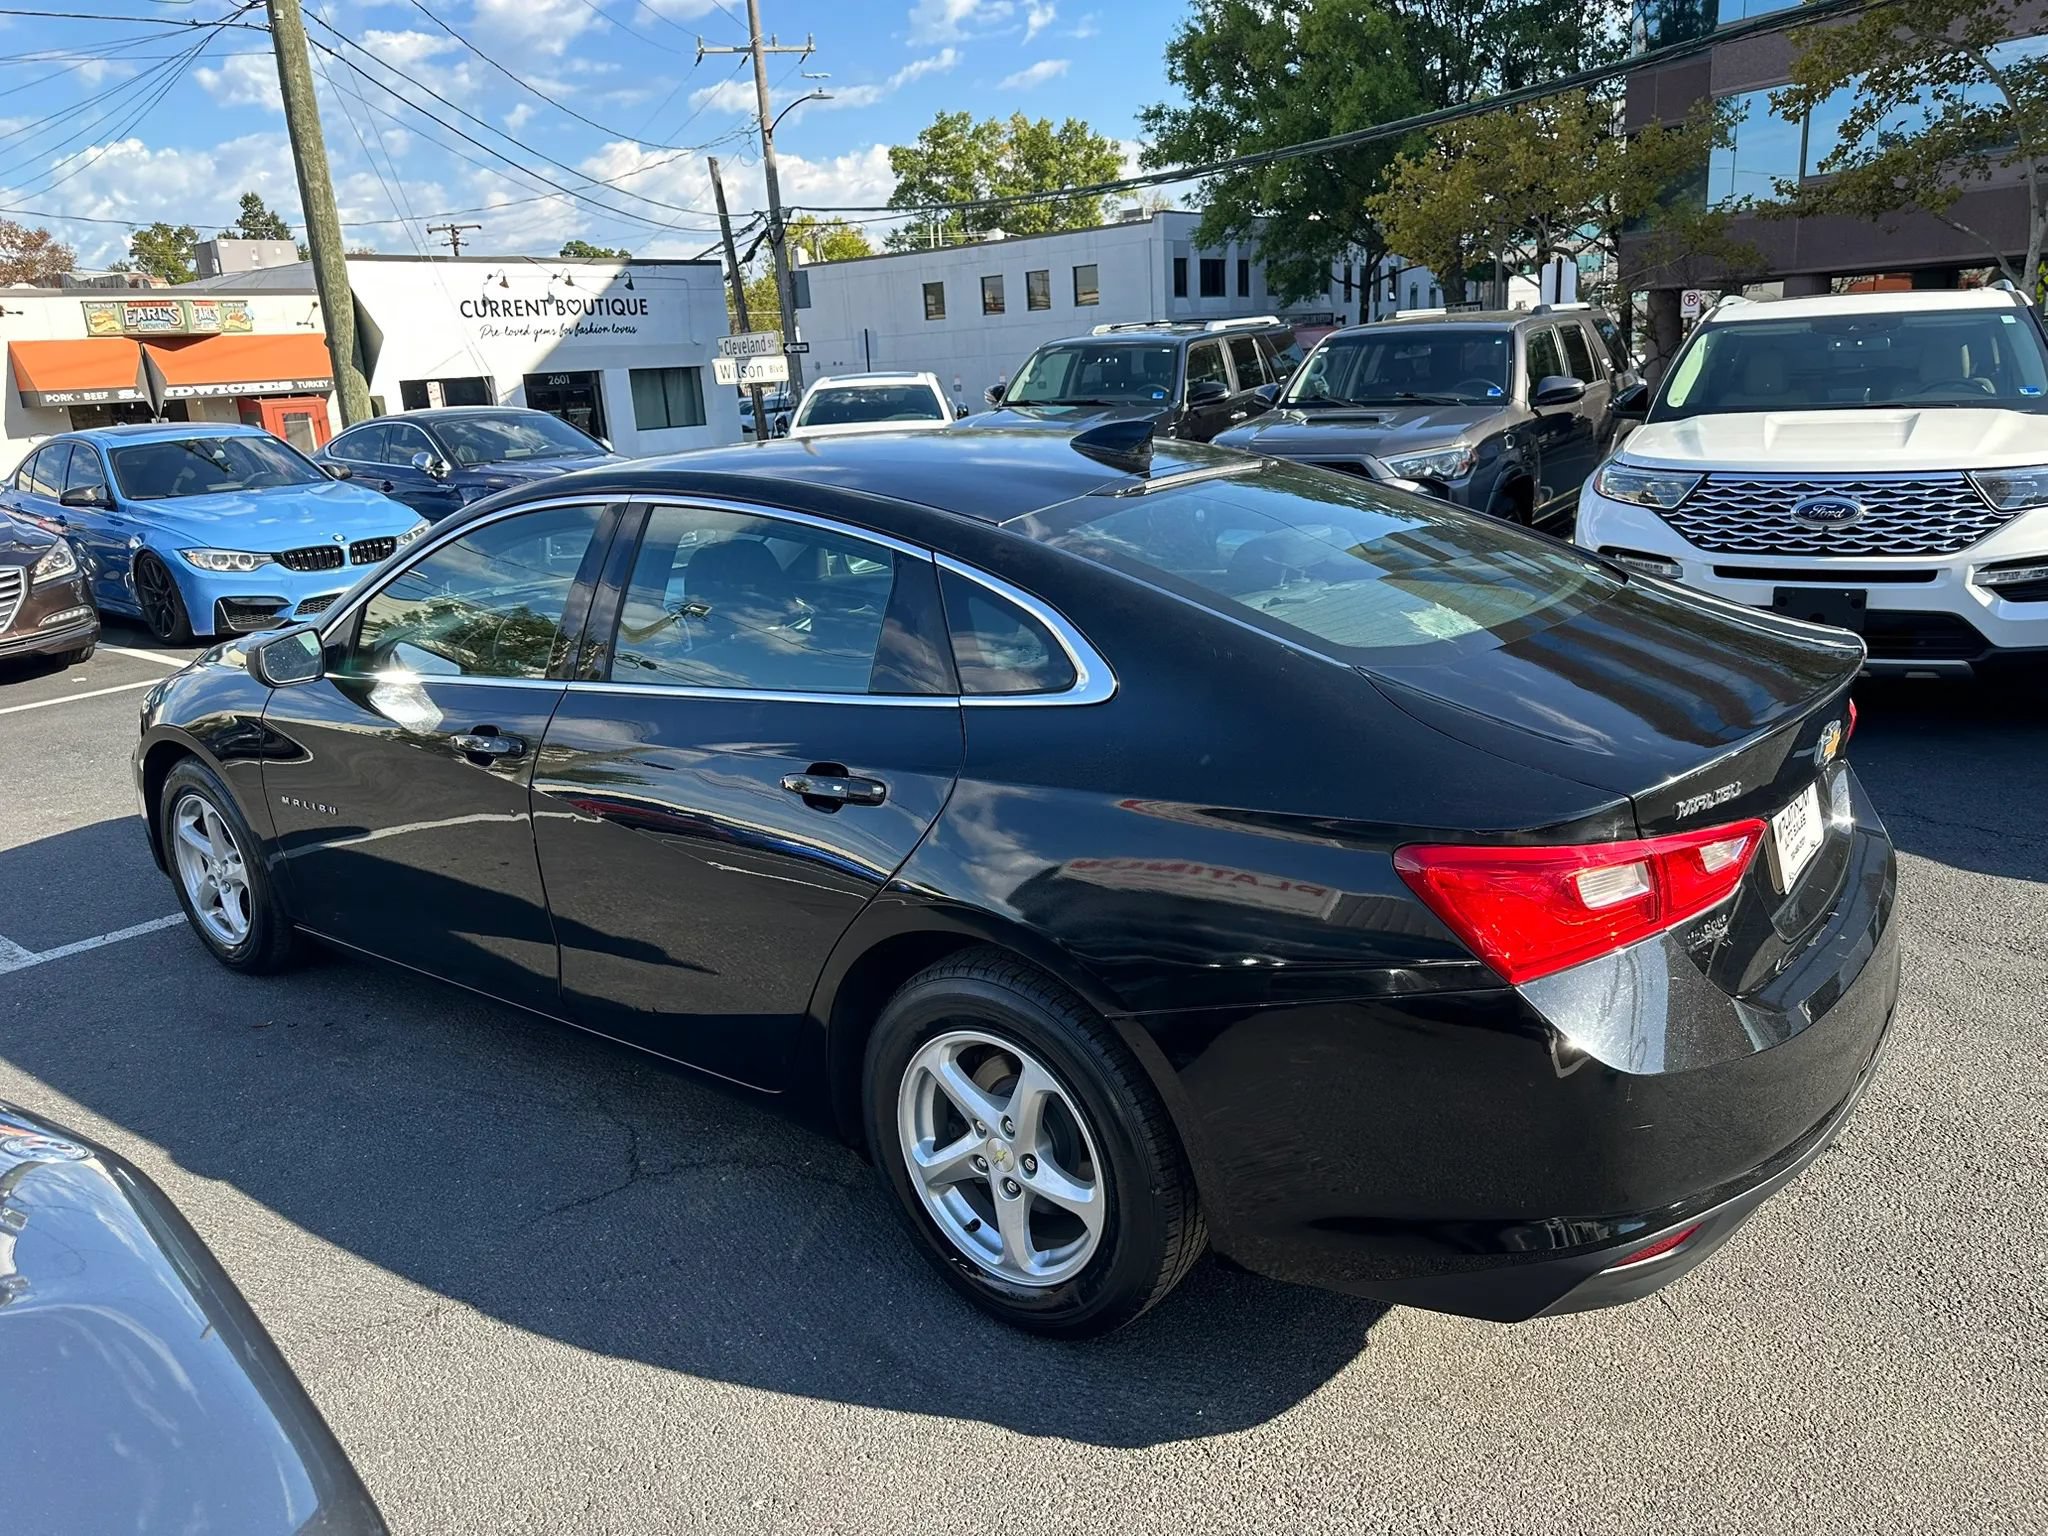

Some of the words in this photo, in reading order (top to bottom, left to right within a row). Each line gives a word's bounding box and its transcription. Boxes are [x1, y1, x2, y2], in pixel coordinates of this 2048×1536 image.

[460, 299, 549, 319] CURRENT
[574, 322, 610, 338] fashion
[724, 335, 767, 355] Cleveland
[719, 362, 764, 379] Wilson
[548, 375, 570, 385] 2601
[45, 393, 75, 403] PORK
[83, 391, 109, 401] BEEF
[296, 379, 329, 389] TURKEY
[1808, 504, 1846, 519] Ford
[281, 795, 338, 816] MALIBU
